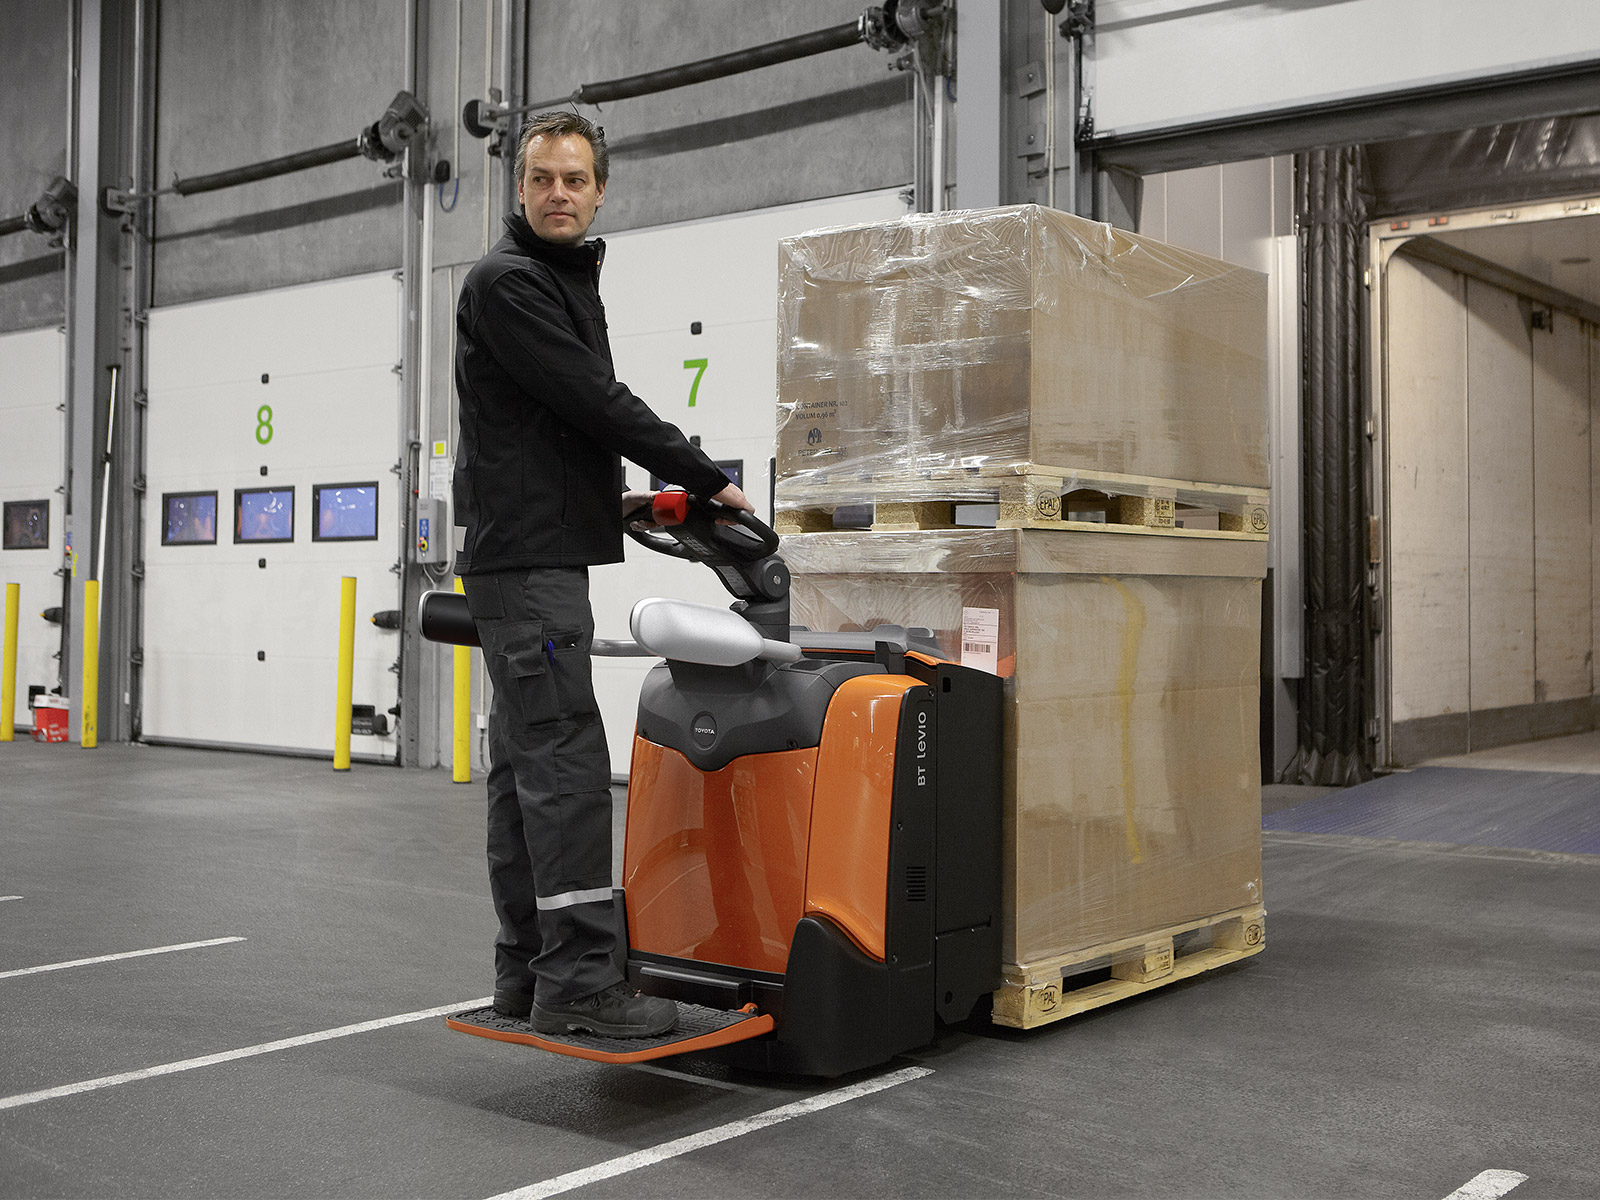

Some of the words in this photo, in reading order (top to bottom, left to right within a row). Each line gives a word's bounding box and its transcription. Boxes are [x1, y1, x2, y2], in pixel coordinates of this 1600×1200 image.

[684, 358, 708, 407] 7
[796, 412, 816, 420] VOLUM
[256, 405, 273, 445] 8
[1040, 496, 1057, 511] EPAL
[695, 727, 715, 735] TOYOTA
[917, 766, 926, 786] BT
